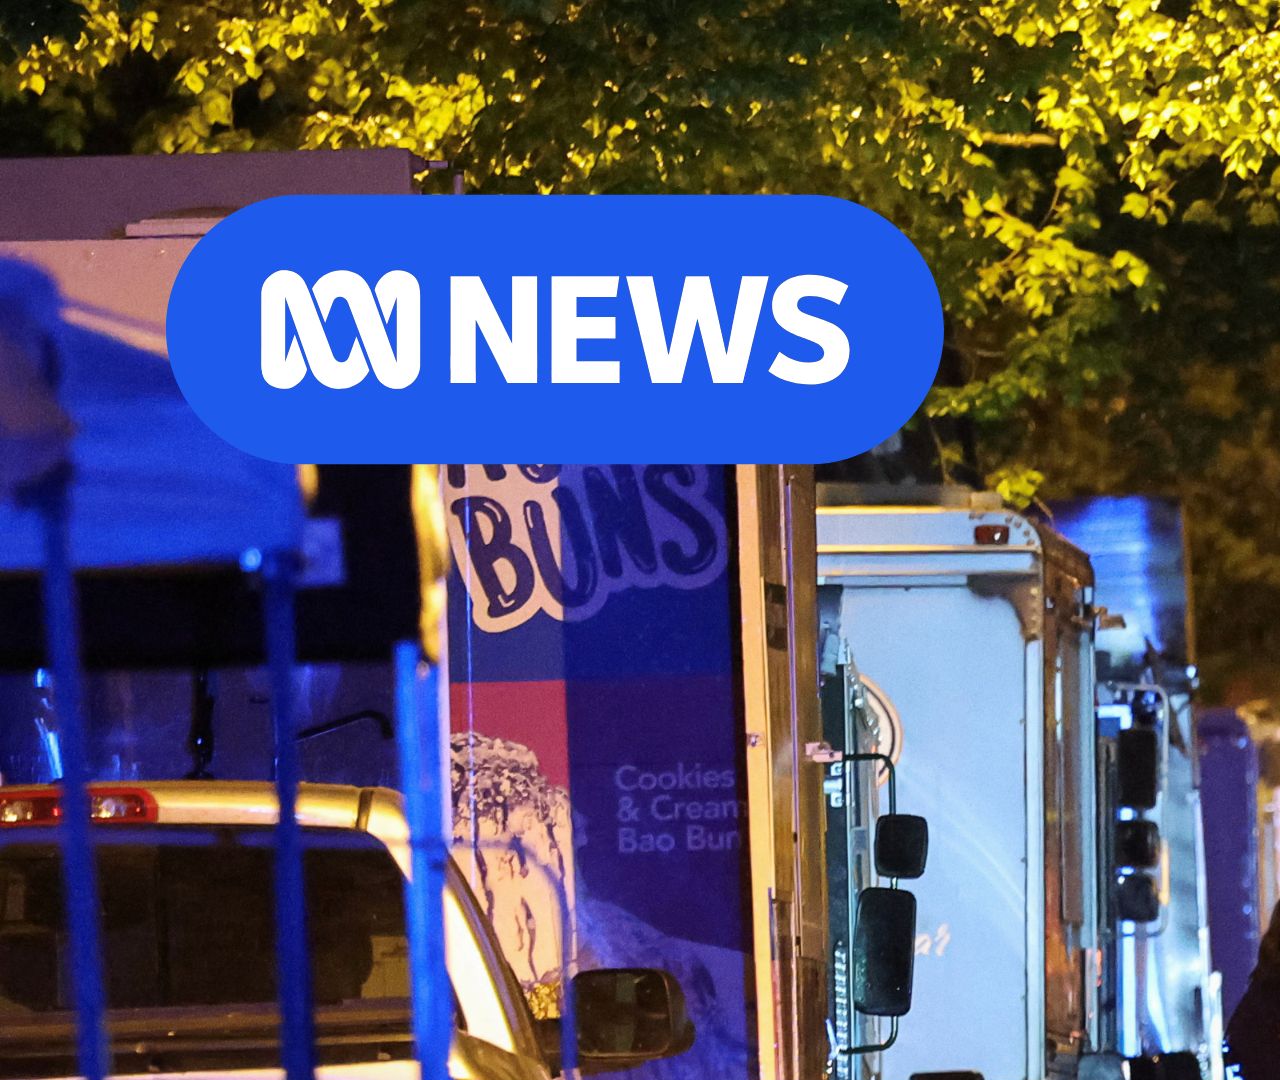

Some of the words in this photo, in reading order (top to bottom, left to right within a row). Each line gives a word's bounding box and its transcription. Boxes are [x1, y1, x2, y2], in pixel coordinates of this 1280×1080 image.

[450, 464, 718, 619] BUNS
[615, 762, 736, 791] Cookies
[617, 796, 640, 822] &
[618, 827, 676, 853] Bao
